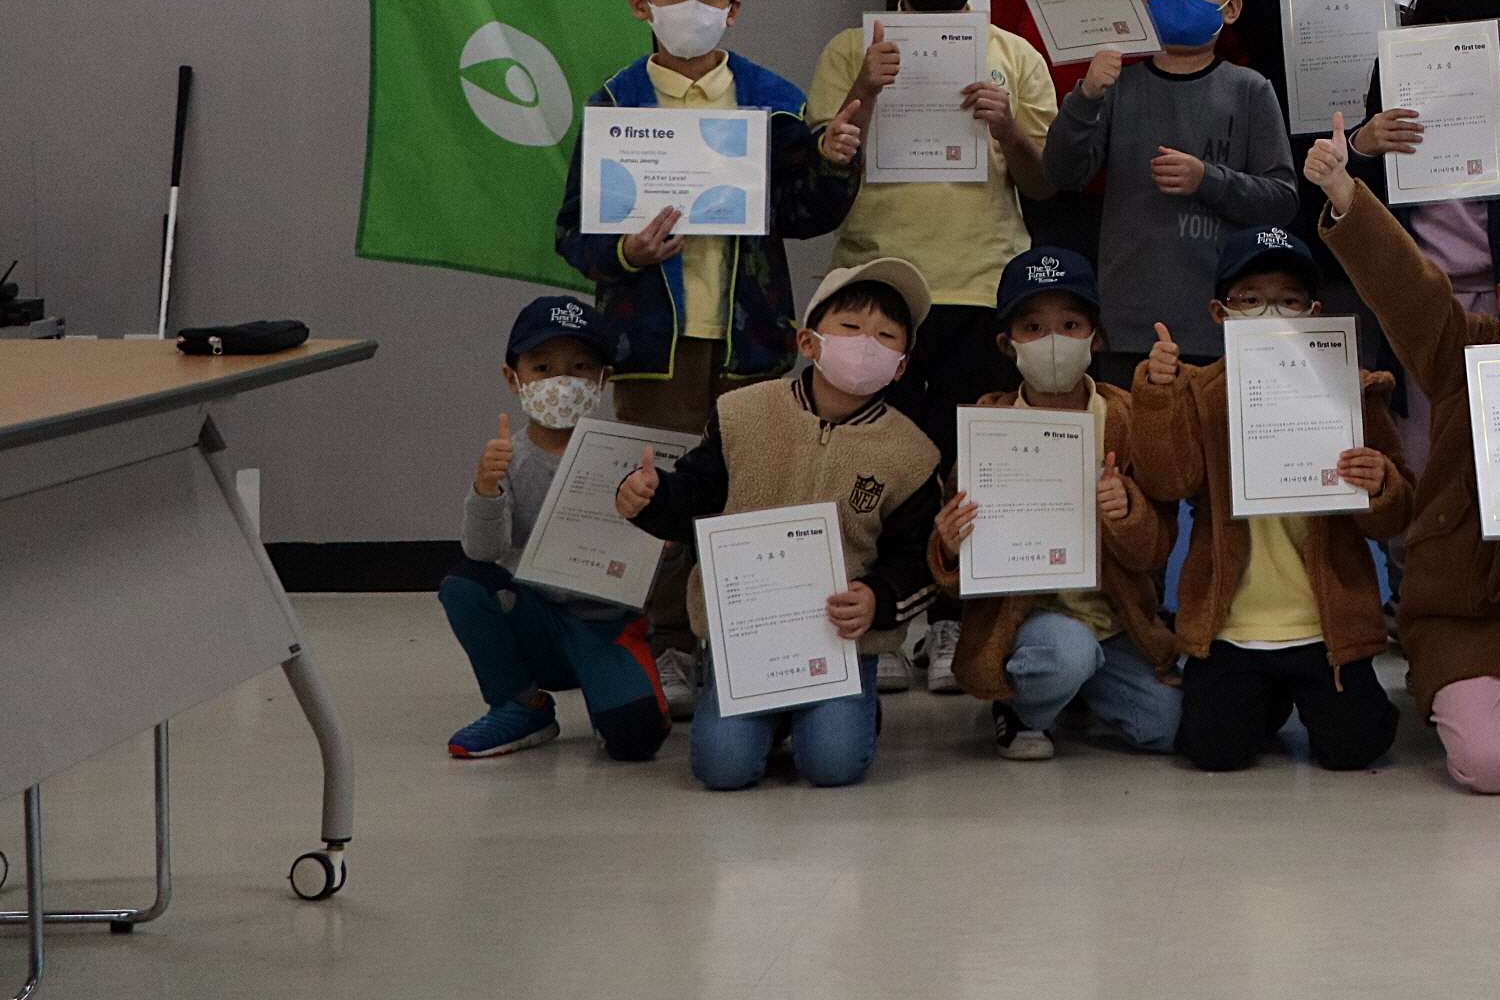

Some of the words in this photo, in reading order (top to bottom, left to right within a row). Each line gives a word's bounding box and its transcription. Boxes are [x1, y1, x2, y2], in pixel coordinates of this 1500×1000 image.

[625, 126, 649, 138] first
[652, 128, 675, 138] tee
[1202, 137, 1231, 162] AM
[1178, 213, 1222, 241] YOU?
[1026, 266, 1043, 274] The
[1028, 271, 1046, 280] First
[1052, 269, 1066, 277] Tee
[851, 489, 875, 510] NFL
[795, 529, 810, 537] first
